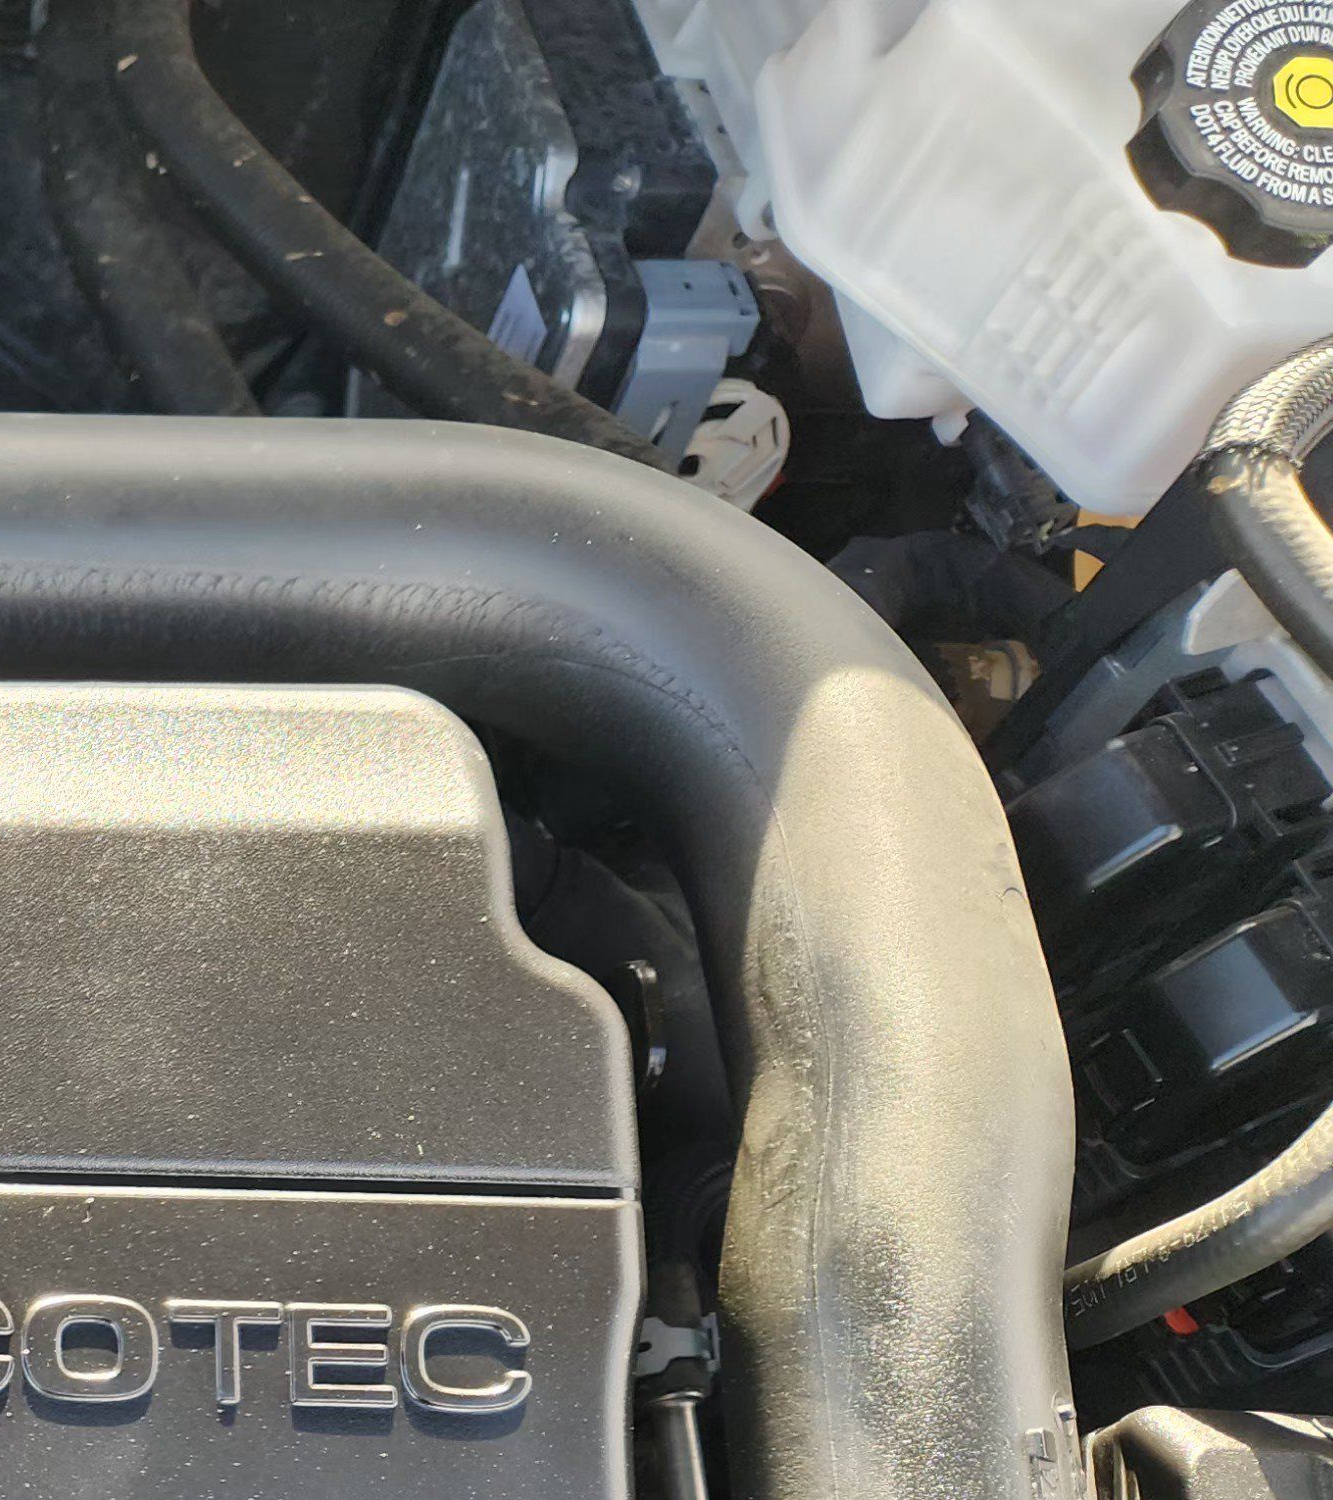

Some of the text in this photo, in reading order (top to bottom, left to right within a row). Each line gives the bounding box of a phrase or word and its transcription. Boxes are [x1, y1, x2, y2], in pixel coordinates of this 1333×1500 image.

[1250, 8, 1282, 32] QUE
[1277, 5, 1300, 23] DU
[1234, 28, 1289, 88] PROVENANT
[1190, 104, 1221, 135] DOT
[1236, 96, 1300, 160] WARNING:
[1207, 134, 1225, 146] 4
[1213, 100, 1243, 129] CAP
[1229, 128, 1289, 175] BEFORE
[1213, 141, 1260, 181] FLUID
[1256, 172, 1307, 204] FROM
[1307, 187, 1321, 204] A
